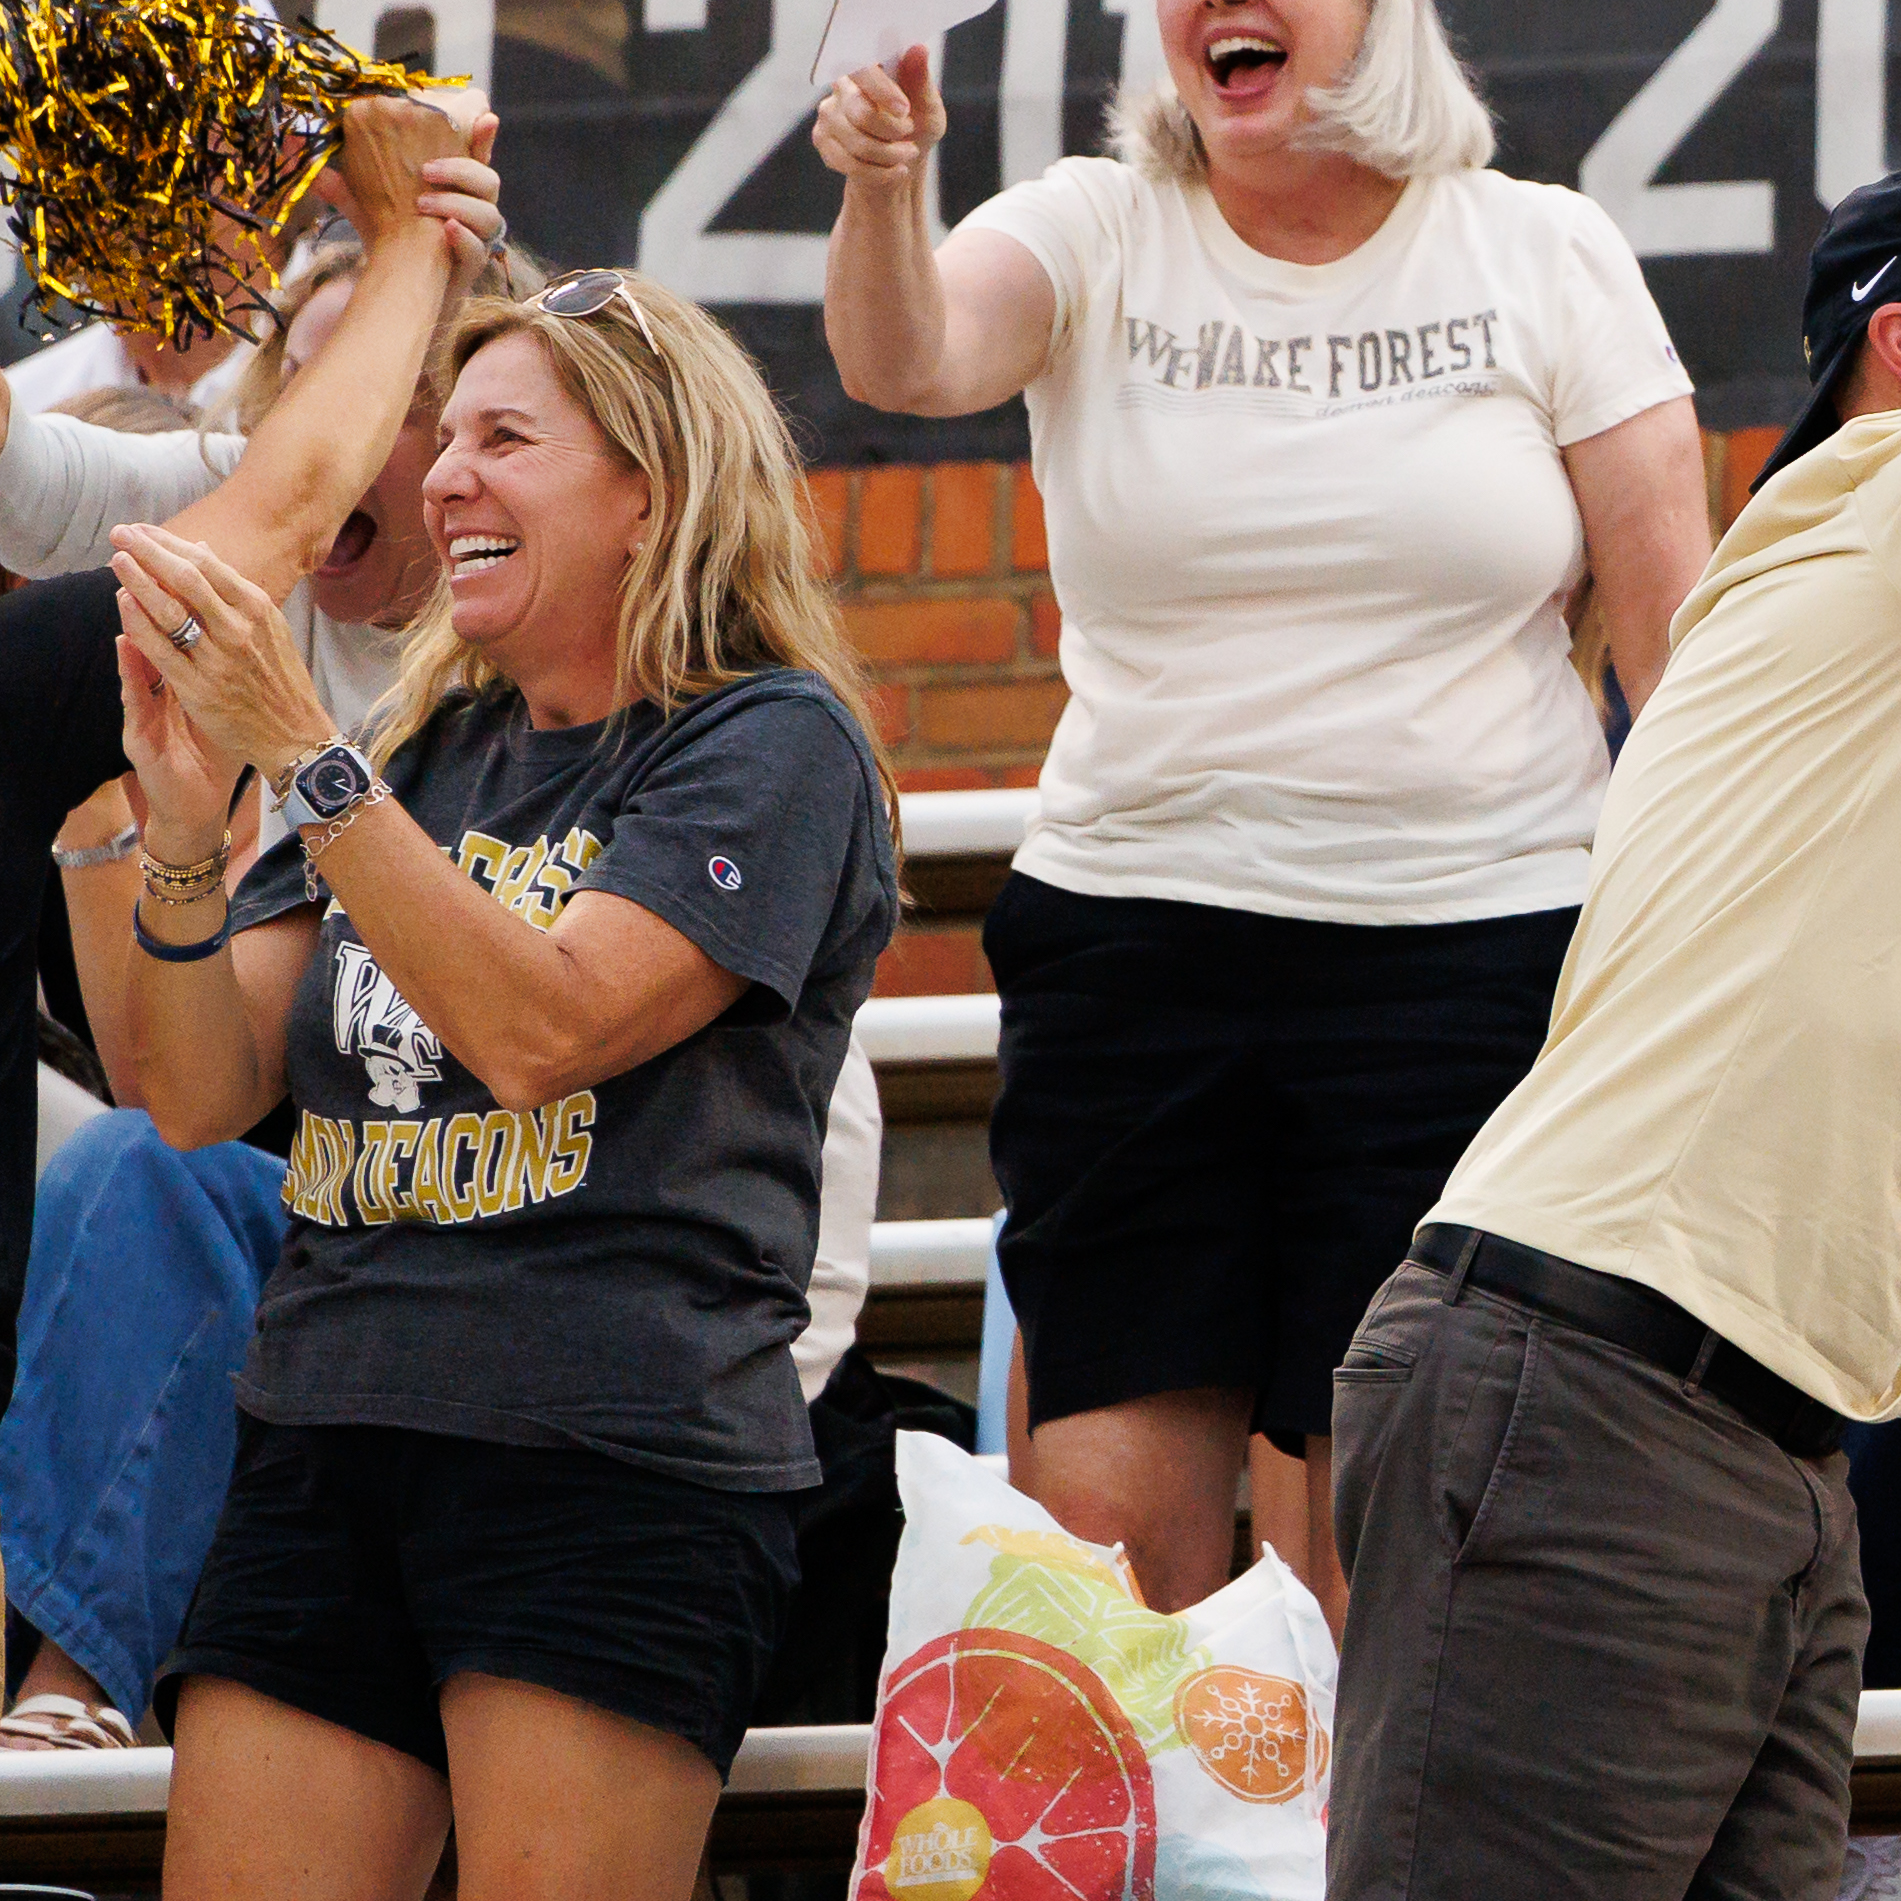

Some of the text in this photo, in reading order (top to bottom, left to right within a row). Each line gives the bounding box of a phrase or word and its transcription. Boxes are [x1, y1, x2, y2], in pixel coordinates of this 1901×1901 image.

[1326, 308, 1499, 399] FOREST
[353, 1089, 597, 1226] DEACONS
[900, 1849, 975, 1878] FOODS
